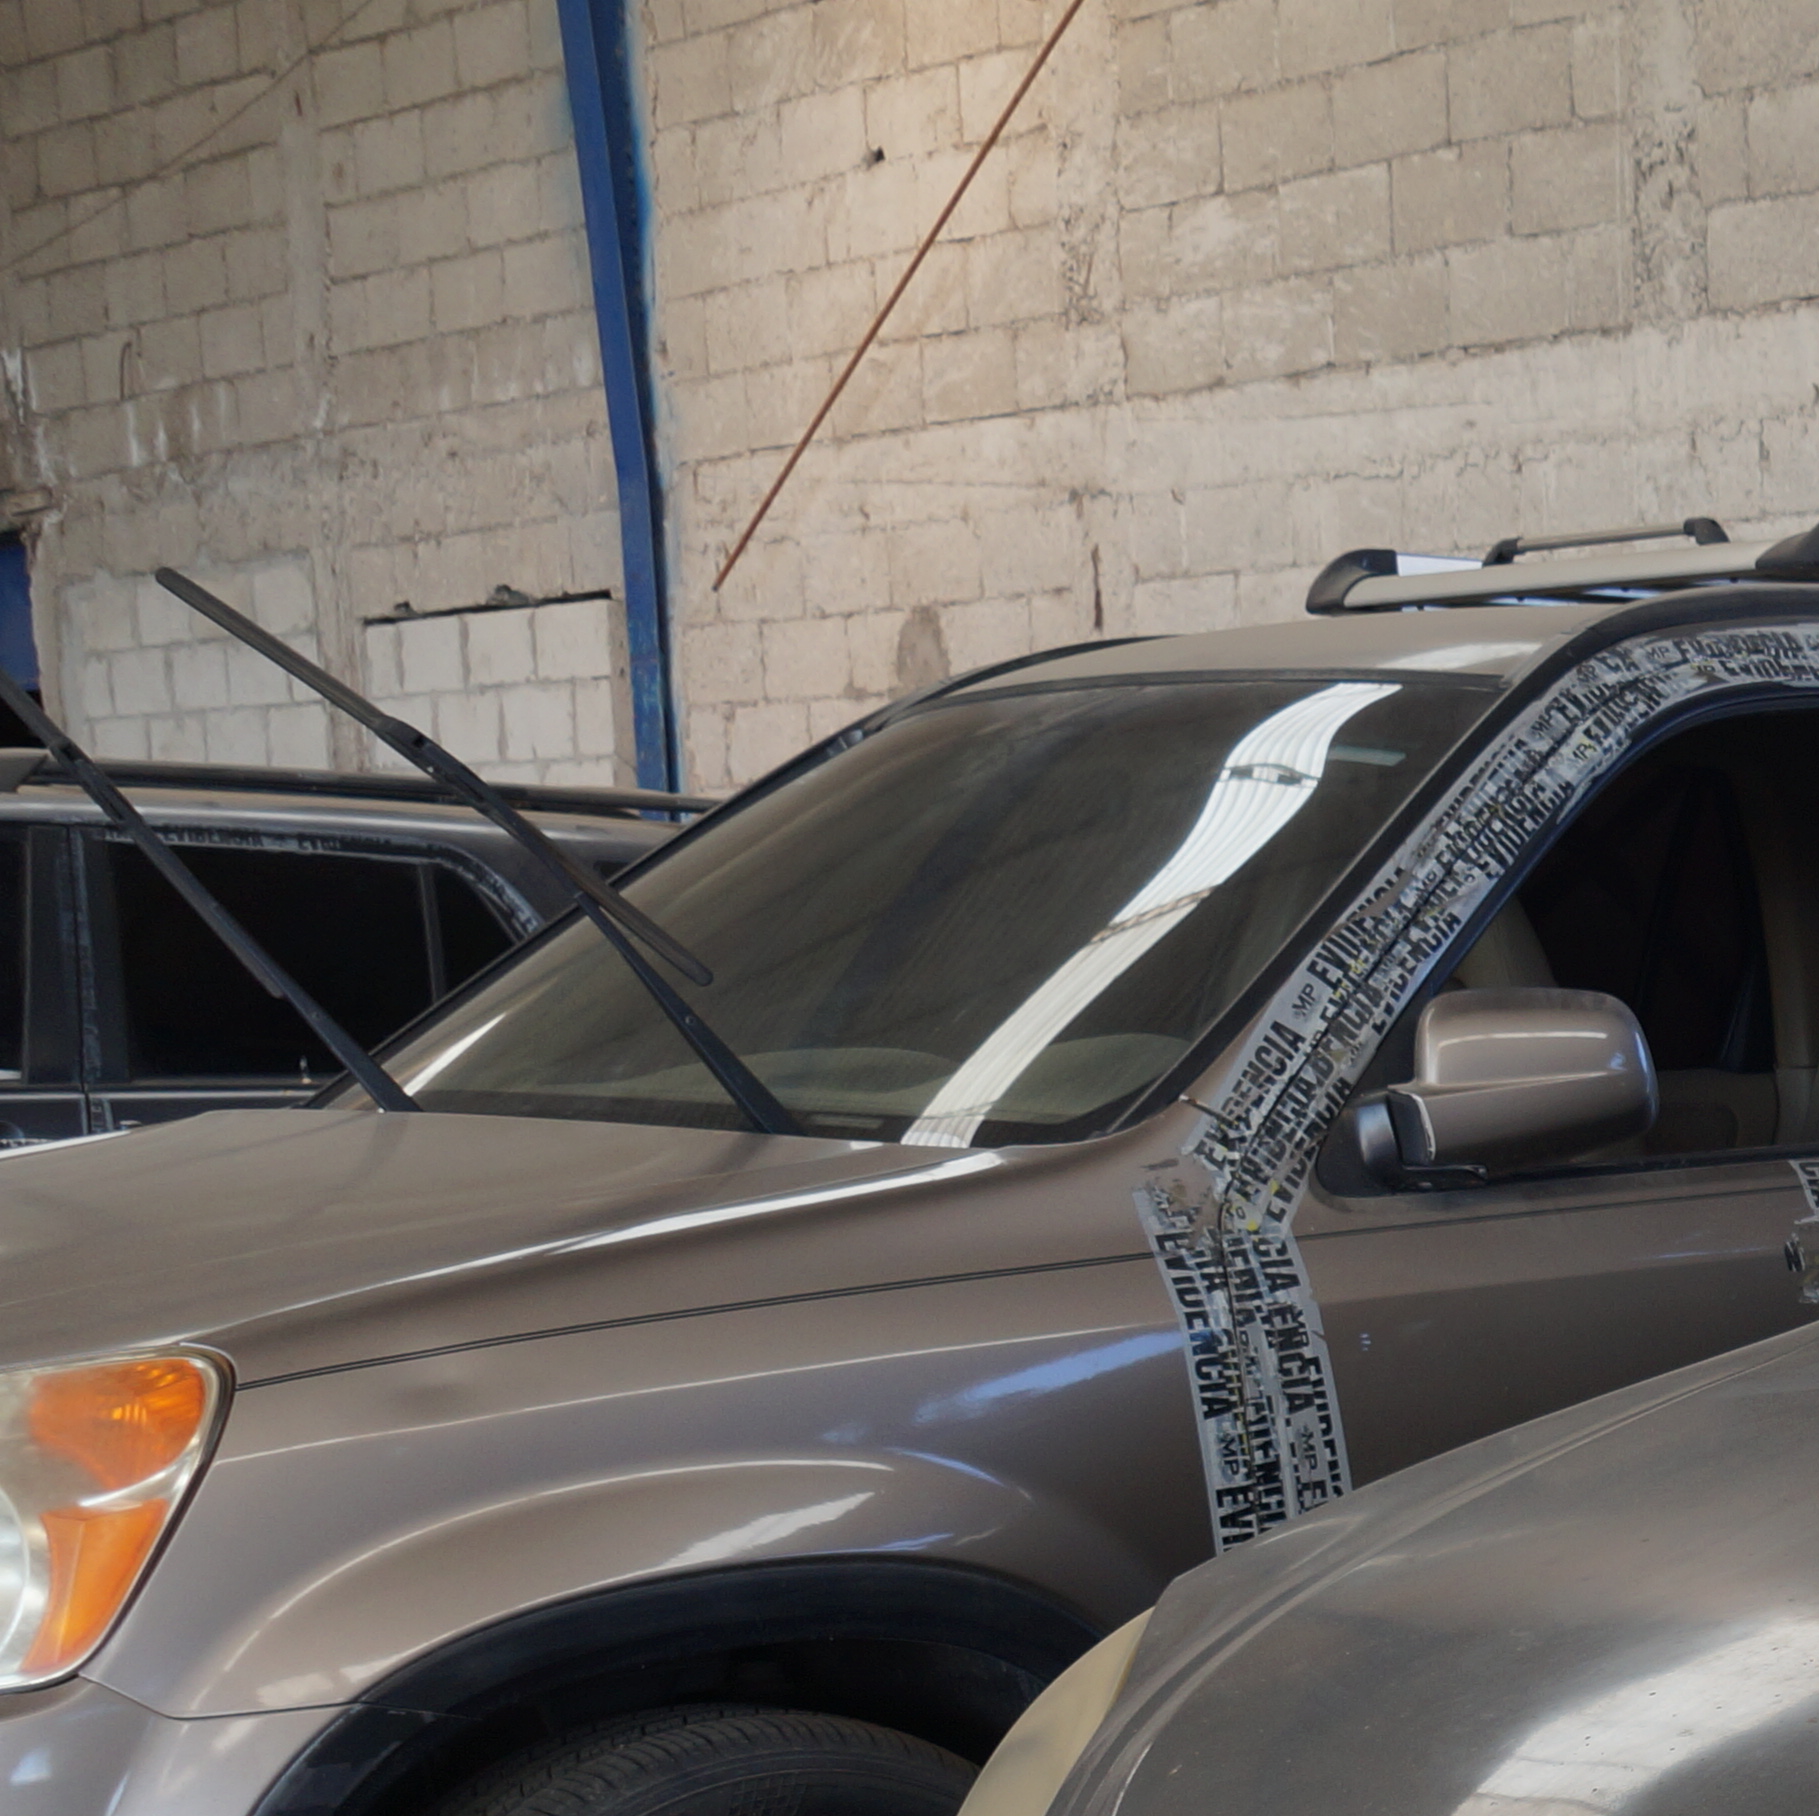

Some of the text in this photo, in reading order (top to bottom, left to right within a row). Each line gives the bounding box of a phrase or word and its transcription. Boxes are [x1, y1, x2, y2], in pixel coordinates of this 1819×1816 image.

[1290, 982, 1322, 1016] MP
[1155, 1231, 1238, 1420] EVIDENCIA
[1219, 1436, 1244, 1477] MP
[1299, 1430, 1321, 1471] MP
